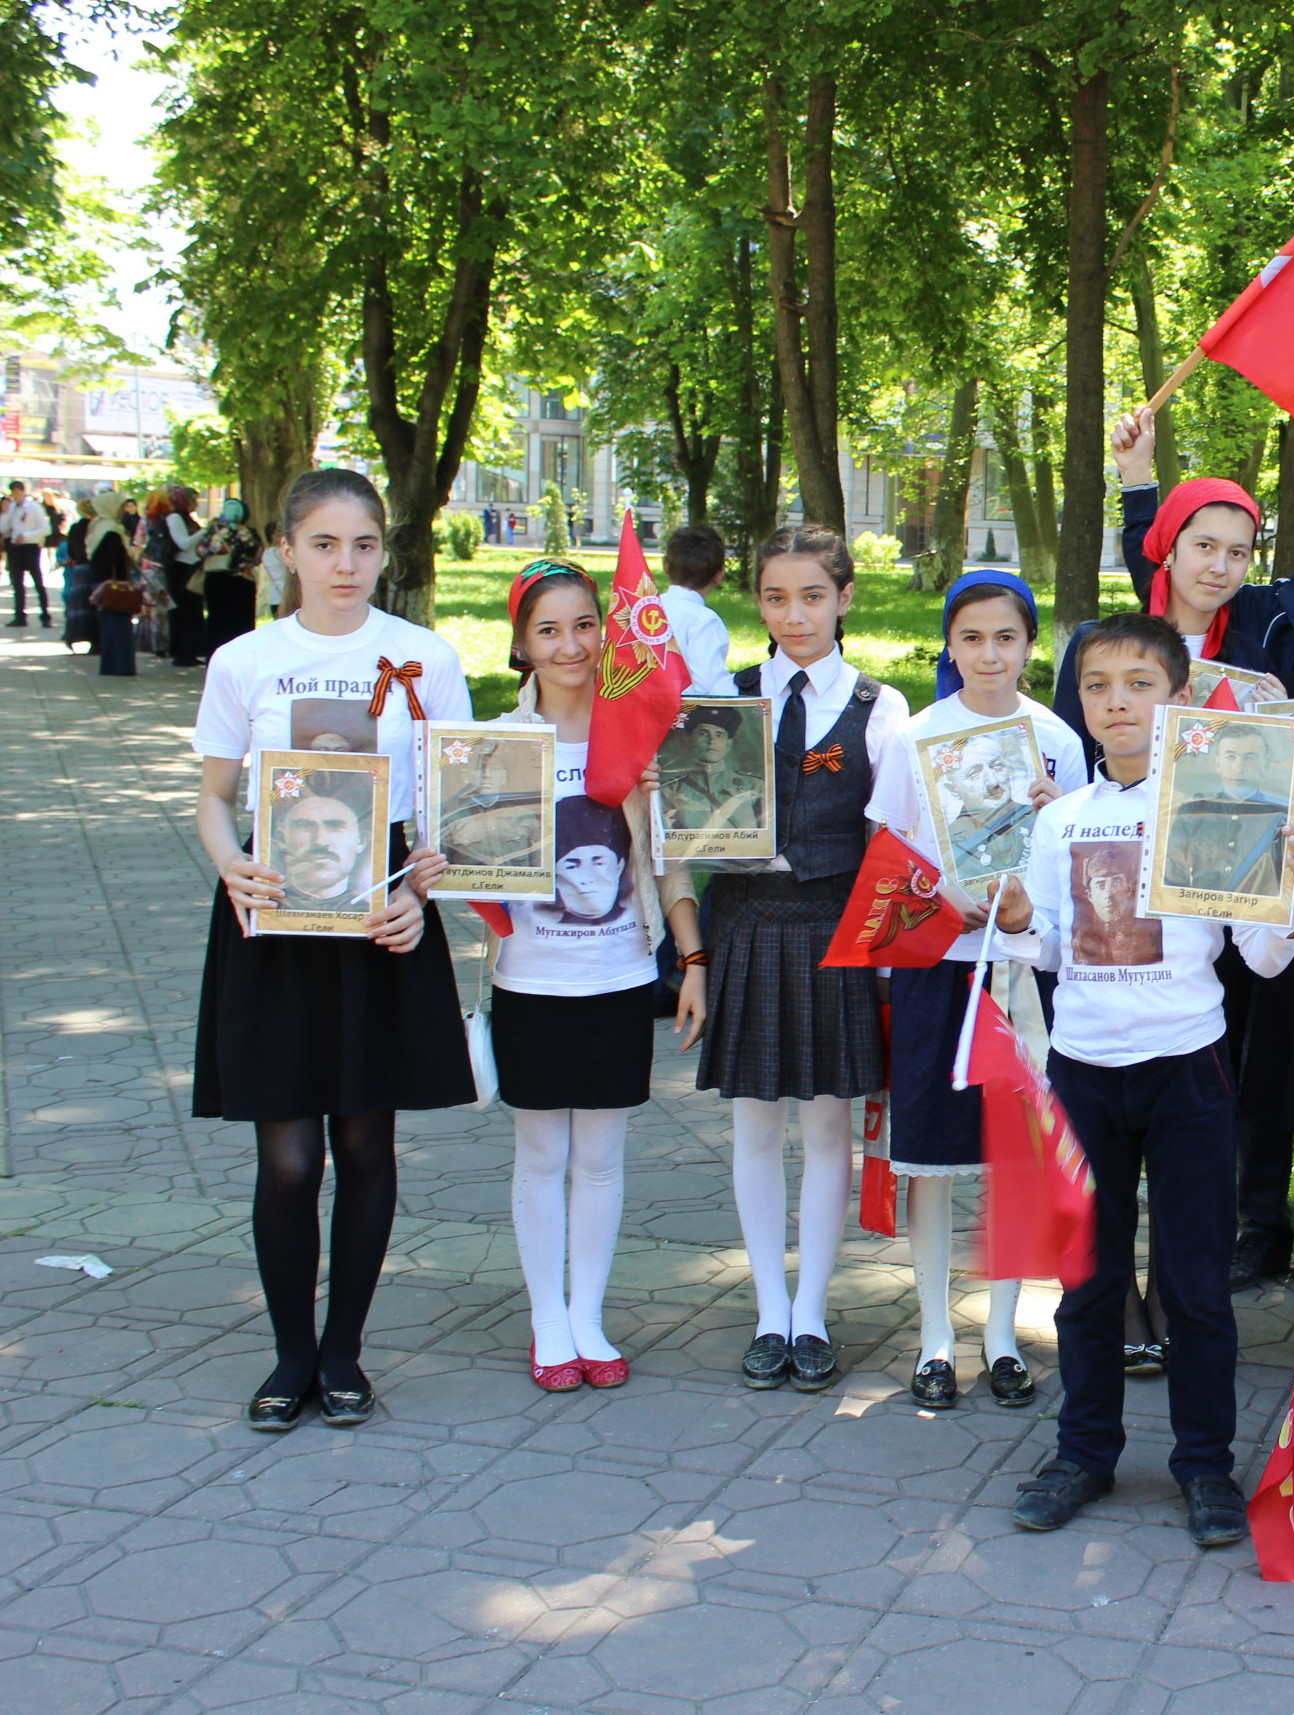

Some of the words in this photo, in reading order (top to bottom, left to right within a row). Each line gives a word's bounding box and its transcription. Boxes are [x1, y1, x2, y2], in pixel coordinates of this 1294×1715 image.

[276, 677, 318, 695] Мой
[733, 831, 758, 840] Абий
[1061, 824, 1077, 839] Я
[471, 882, 504, 890] с.Гели
[1179, 888, 1224, 902] Загиров
[1226, 893, 1259, 906] Загир
[1198, 906, 1233, 918] с.Гели
[303, 923, 334, 932] с.Гели
[1065, 966, 1116, 982] Шихасанов
